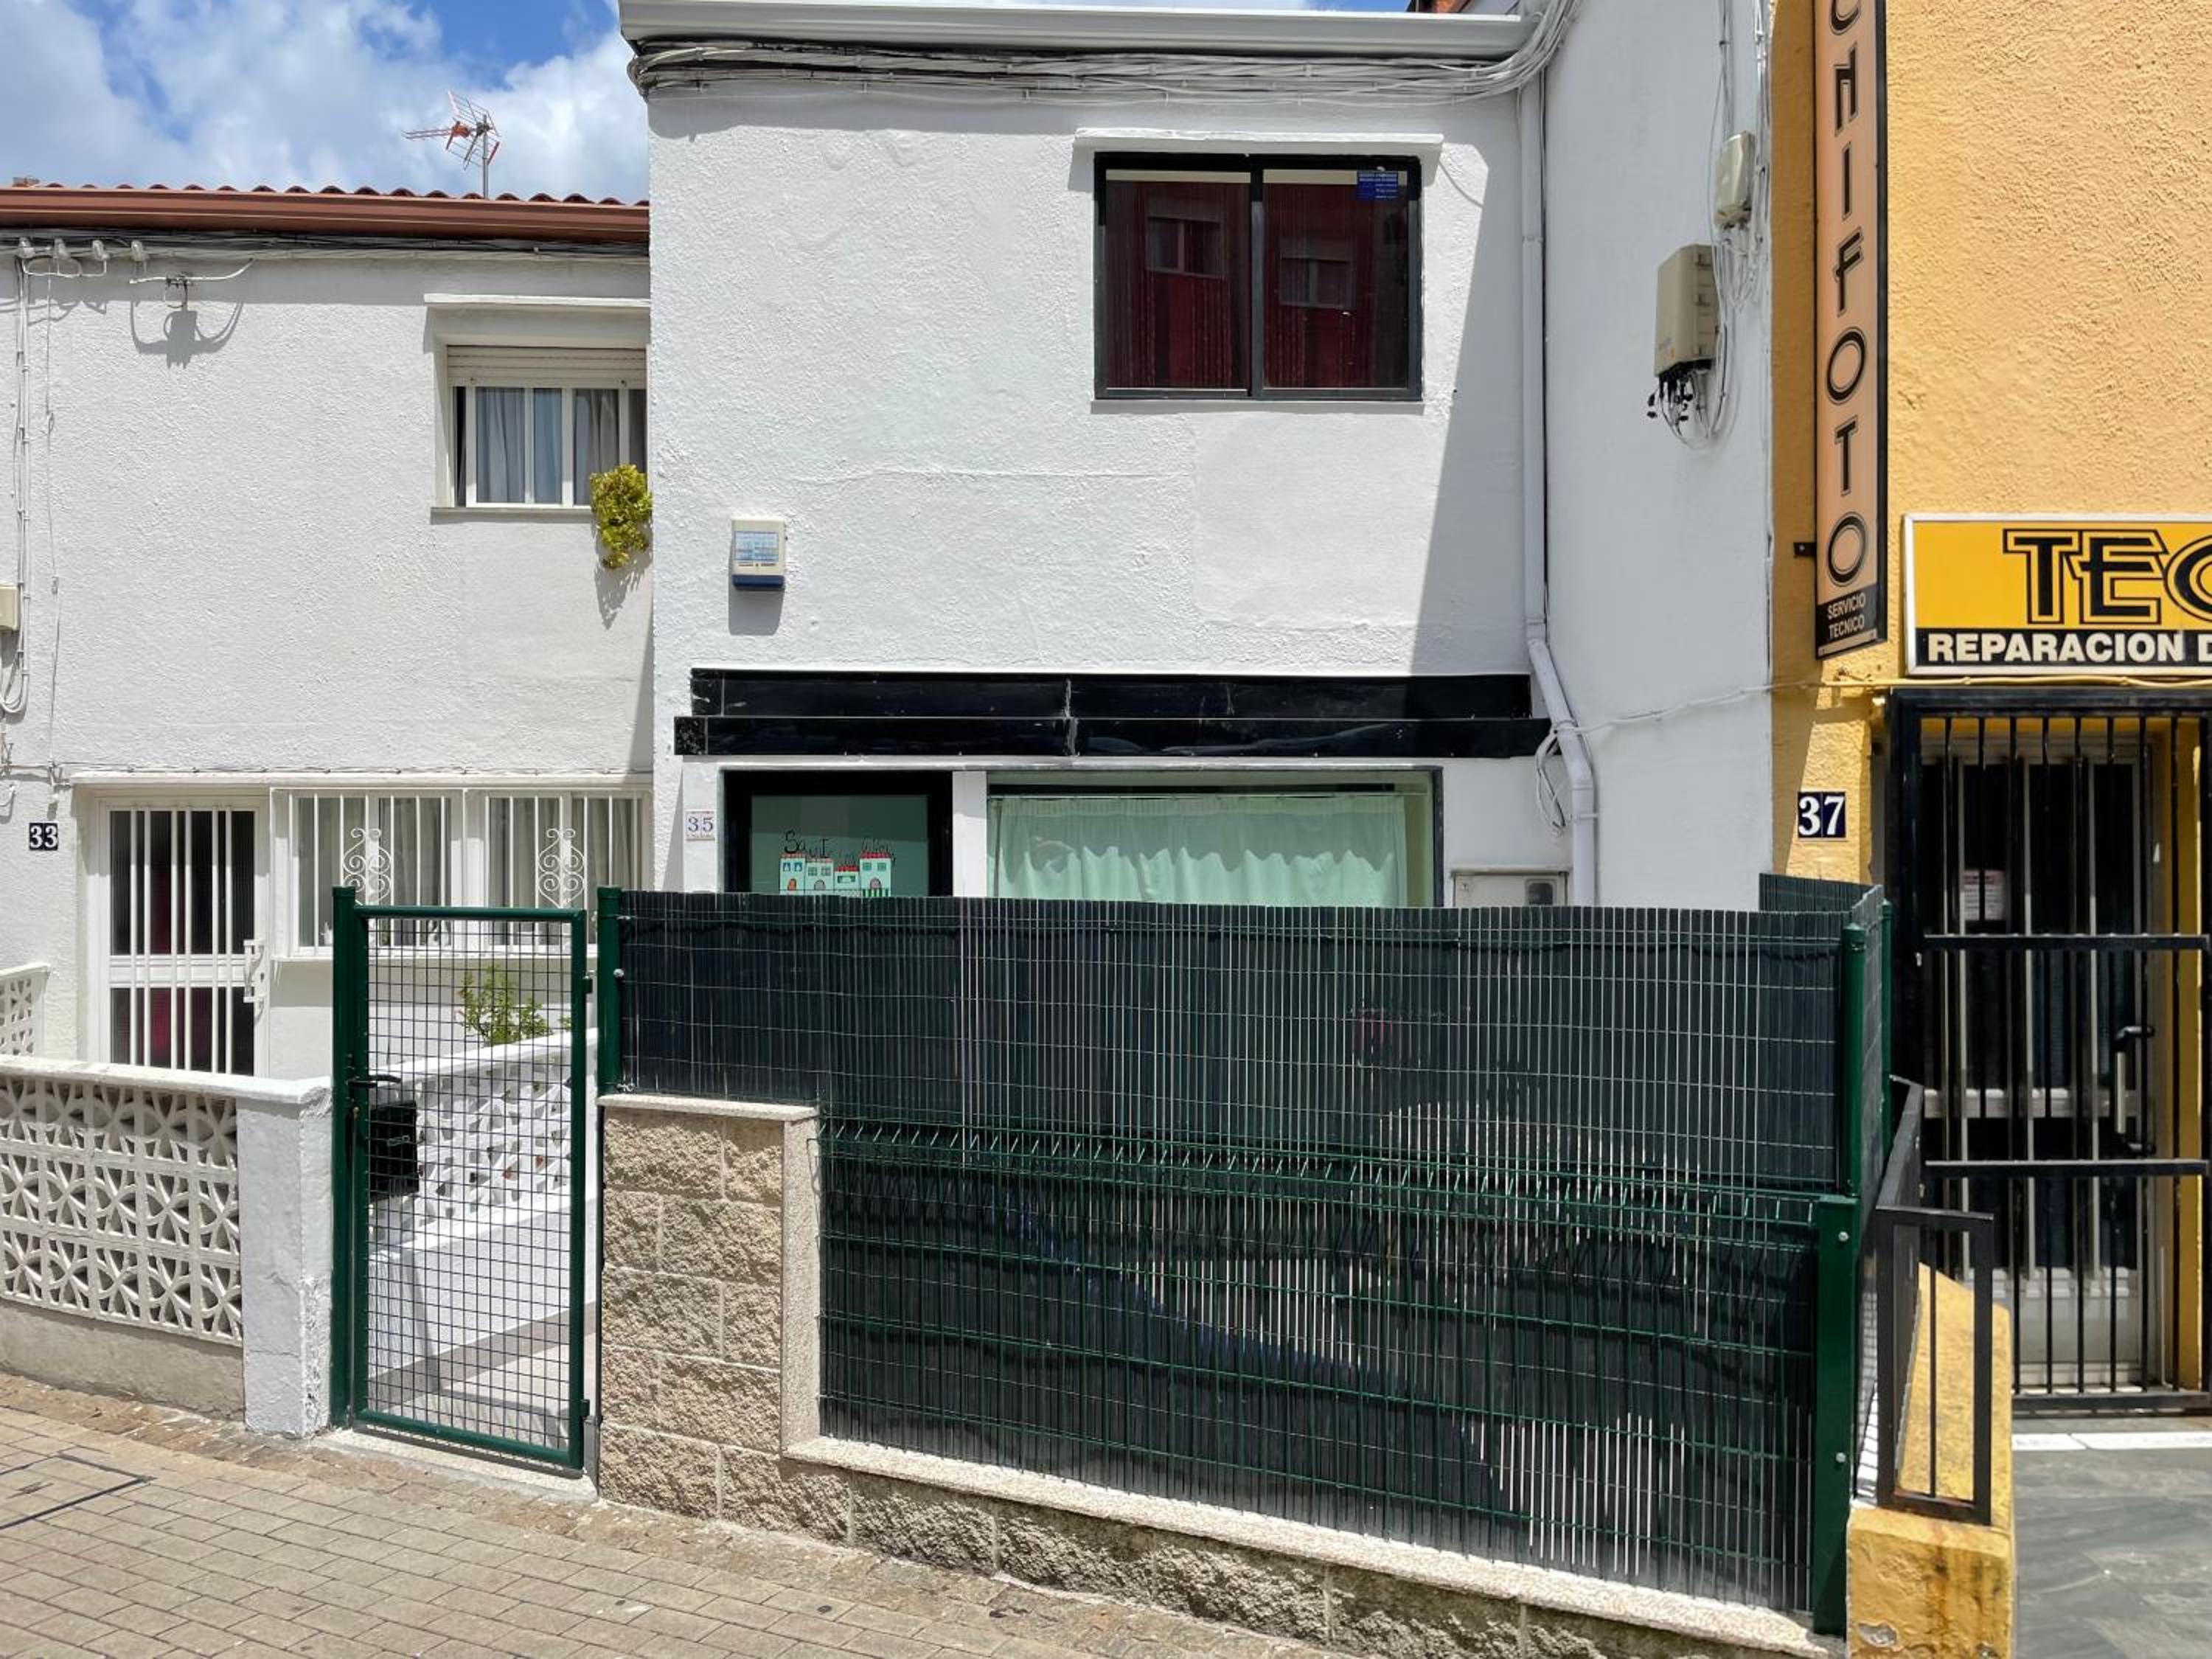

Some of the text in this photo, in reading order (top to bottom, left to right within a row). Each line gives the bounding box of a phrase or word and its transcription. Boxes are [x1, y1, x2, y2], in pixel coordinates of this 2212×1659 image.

[1828, 592, 1866, 620] SERVICIO
[1829, 614, 1865, 639] TECNICO
[1928, 633, 2183, 662] REPARACION
[688, 816, 713, 832] 35
[1798, 796, 1845, 835] 37
[30, 825, 58, 848] 33
